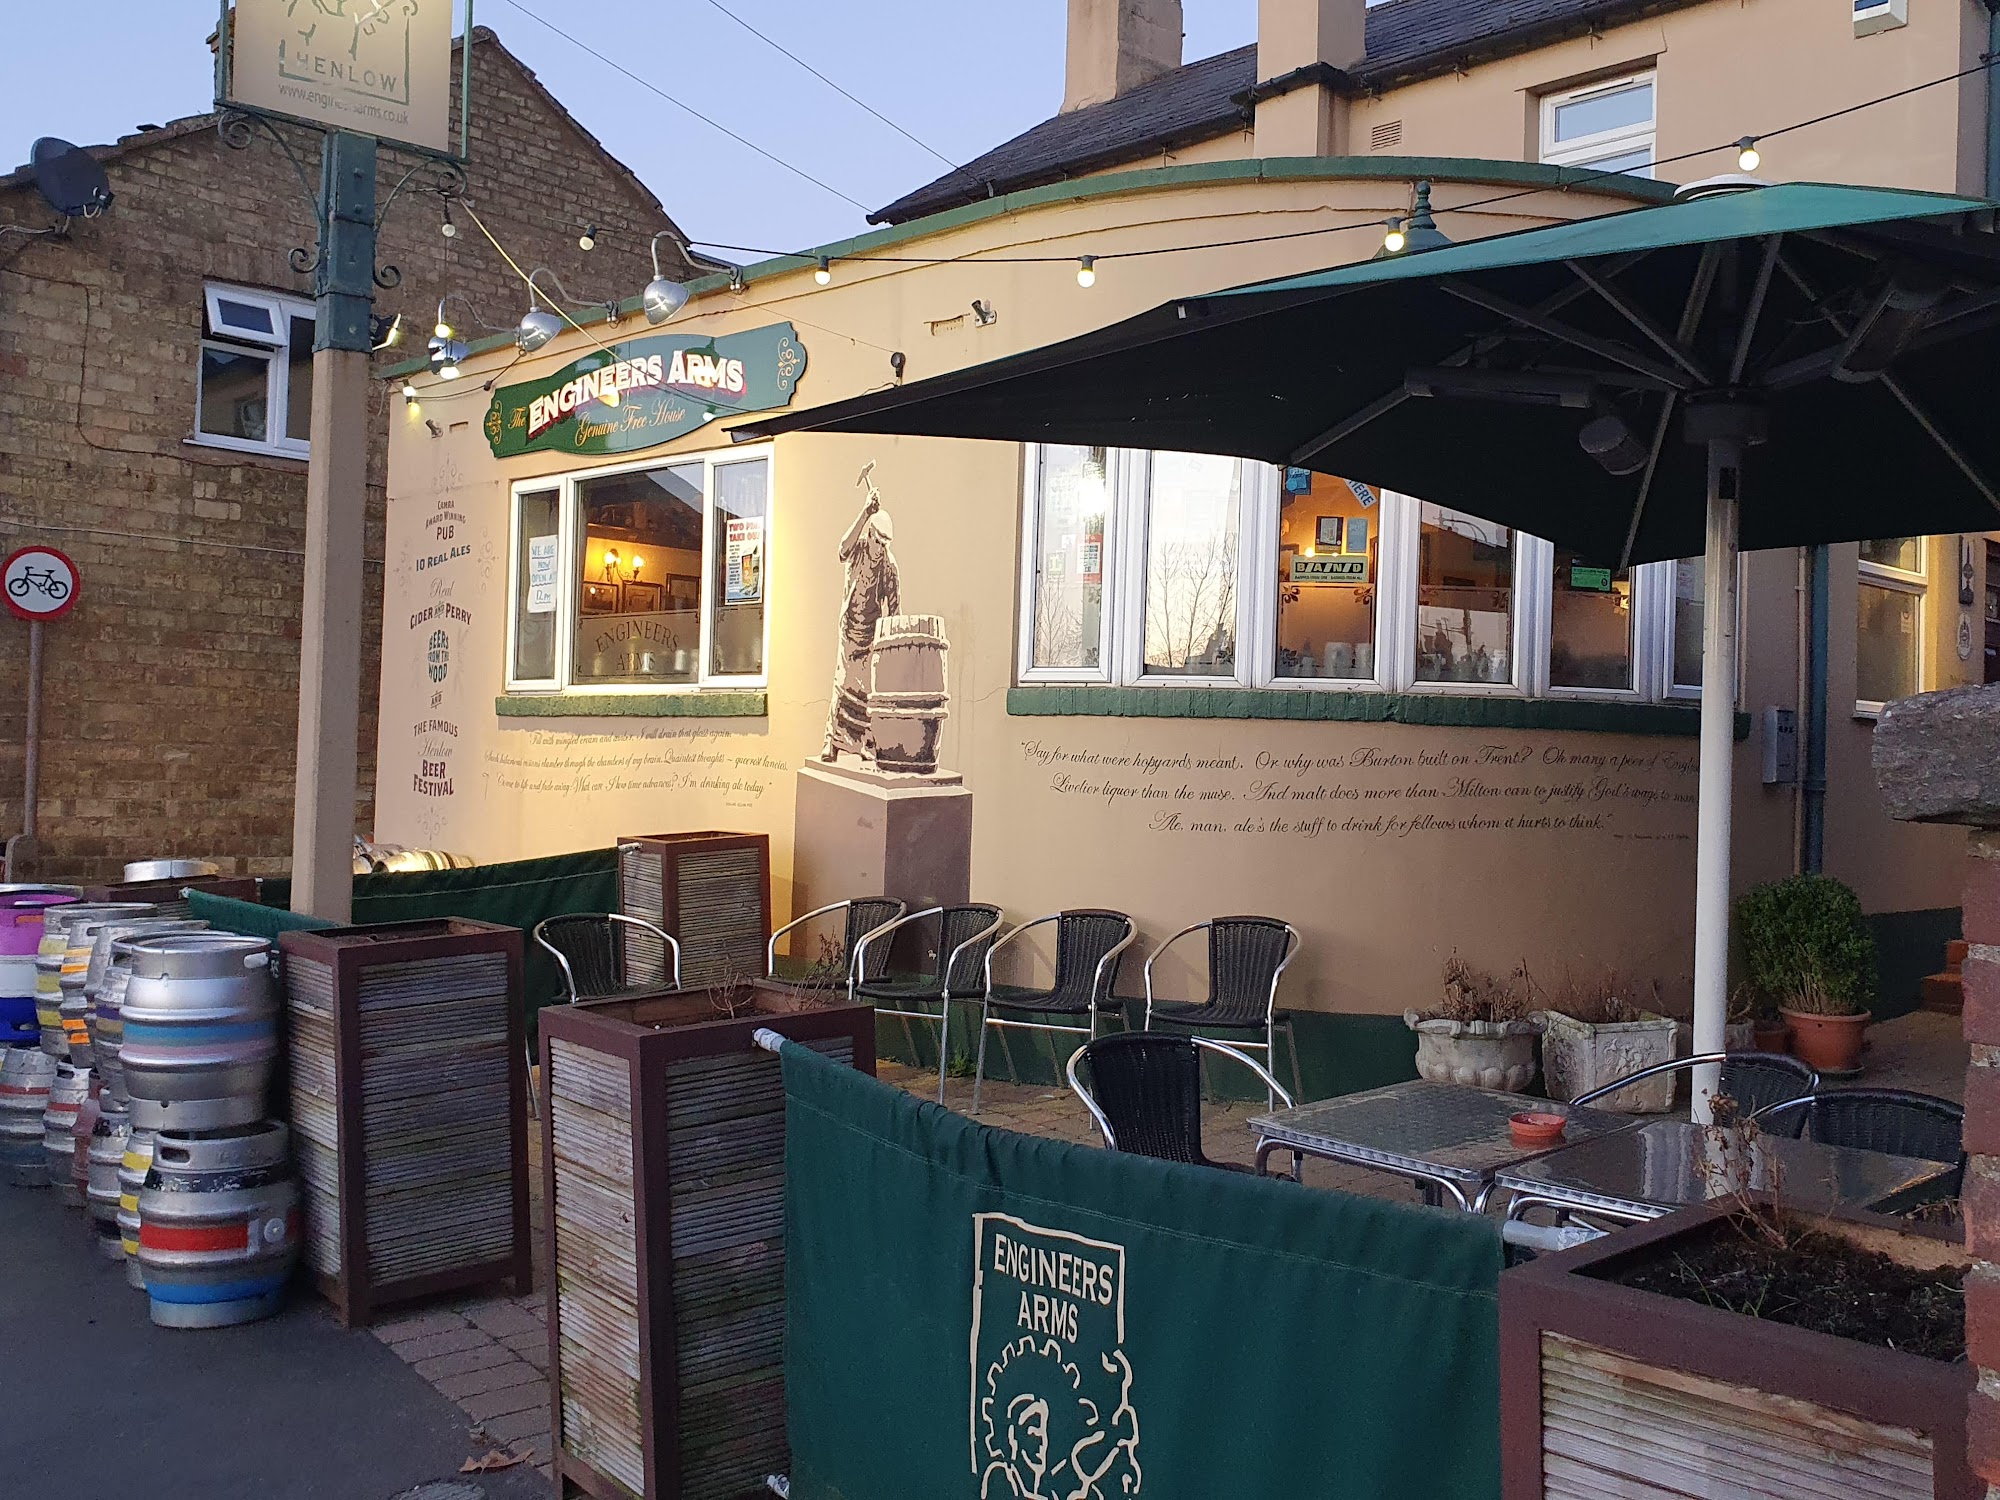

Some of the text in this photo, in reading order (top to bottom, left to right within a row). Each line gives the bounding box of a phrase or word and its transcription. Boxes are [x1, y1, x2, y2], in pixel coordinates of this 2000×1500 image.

[297, 51, 397, 92] HENLOW
[279, 84, 409, 125] www.enginarms.co.uk
[528, 350, 745, 435] ENGINEERS ARMS
[508, 408, 528, 429] The
[575, 399, 686, 446] Genuine Free House
[436, 525, 454, 540] PUB
[729, 522, 745, 532] TWO
[427, 553, 449, 568] REAL
[450, 544, 472, 560] ALES
[410, 606, 434, 629] CIDER
[445, 602, 472, 625] PERRY
[596, 620, 680, 655] ENGINEERS
[414, 719, 459, 737] THE FAMOUS
[422, 759, 446, 779] BEER
[1046, 746, 1069, 765] for
[1070, 749, 1101, 765] what
[1102, 755, 1132, 767] were
[1132, 753, 1192, 775] hopyards
[1196, 756, 1244, 770] meant.
[1255, 751, 1280, 770] Or
[1283, 753, 1314, 777] why
[1316, 756, 1346, 769] was
[1349, 748, 1415, 768] Burton
[1417, 750, 1454, 767] built
[1456, 756, 1476, 766] on
[1475, 745, 1533, 767] Trent?
[1543, 747, 1565, 765] Oh
[1569, 754, 1606, 771] many
[413, 774, 454, 797] FESTIVAL
[1102, 781, 1140, 808] liquor
[1141, 784, 1169, 799] than
[1174, 785, 1195, 800] the
[1199, 789, 1235, 801] muse.
[1243, 780, 1290, 801] And
[1291, 785, 1328, 801] malt
[1329, 784, 1360, 800] does
[1364, 789, 1398, 799] more
[1405, 783, 1440, 798] than
[1441, 777, 1507, 798] Milton
[1509, 787, 1532, 797] can
[1534, 784, 1547, 797] to
[1269, 817, 1289, 832] the
[1294, 816, 1326, 838] stuff
[1326, 819, 1338, 831] to
[1341, 816, 1383, 832] drink
[1375, 815, 1409, 837] for
[1398, 815, 1461, 838] fellows
[1458, 814, 1500, 830] whom
[1503, 816, 1515, 830] it
[1516, 814, 1552, 829] hurts
[1554, 815, 1566, 829] to
[994, 1233, 1114, 1306] ENGINEERS
[1017, 1291, 1079, 1344] ARMS
